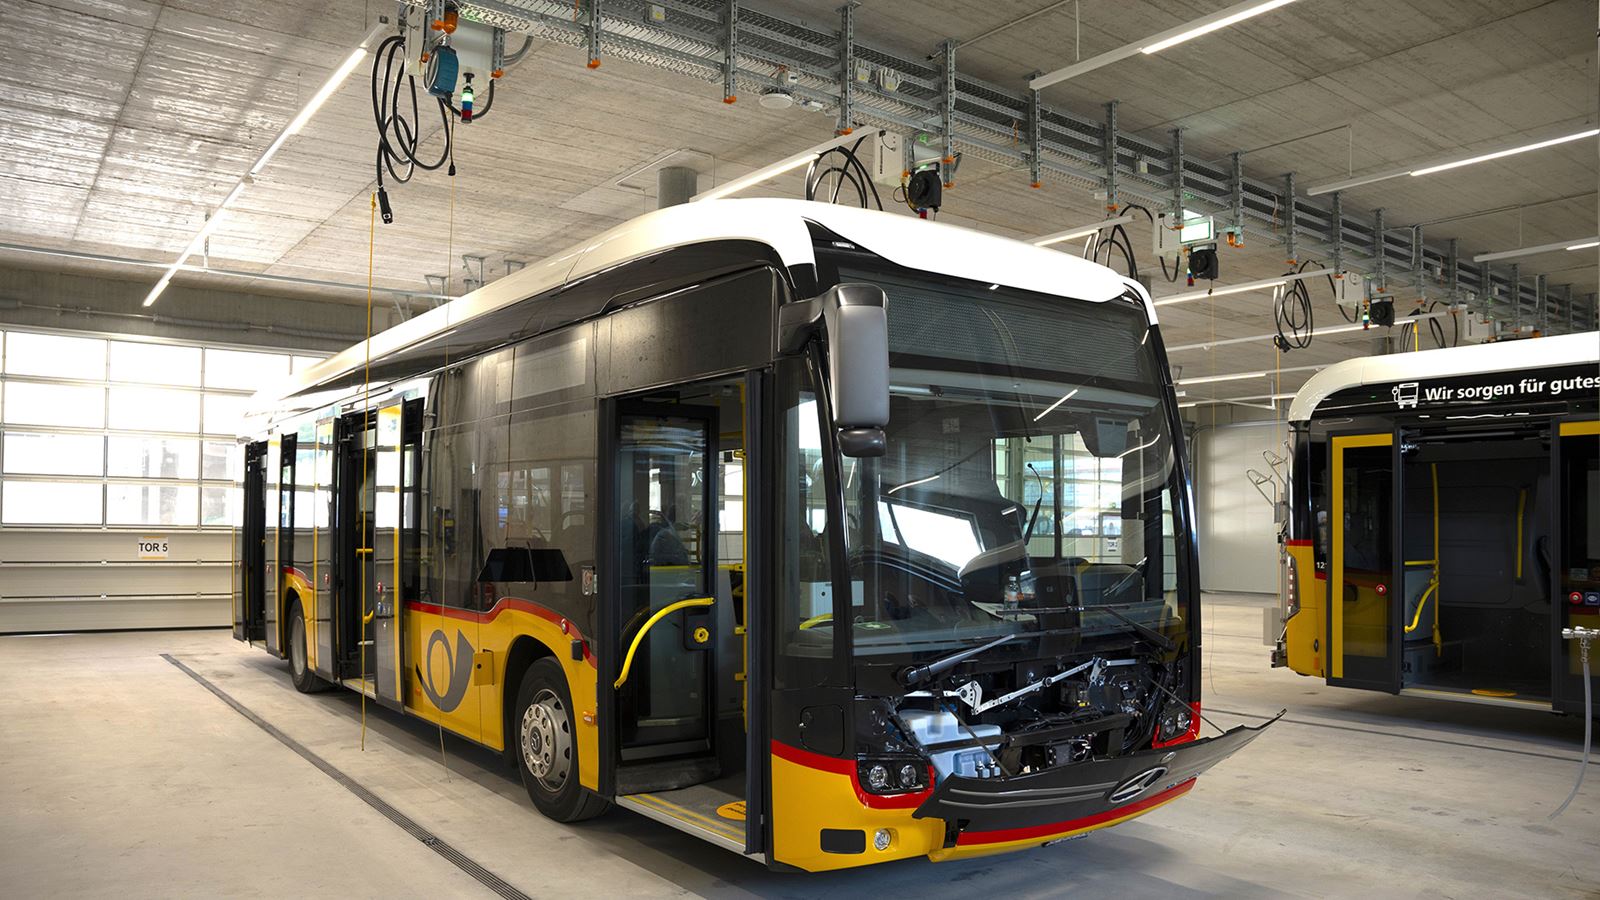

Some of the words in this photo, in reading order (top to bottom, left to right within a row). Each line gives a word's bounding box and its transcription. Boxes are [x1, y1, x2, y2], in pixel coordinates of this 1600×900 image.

[1424, 386, 1453, 400] Wir
[1457, 384, 1514, 400] sorgen
[1519, 378, 1546, 393] für
[1550, 375, 1600, 394] gutes
[138, 543, 160, 552] TOR
[162, 543, 168, 552] 5
